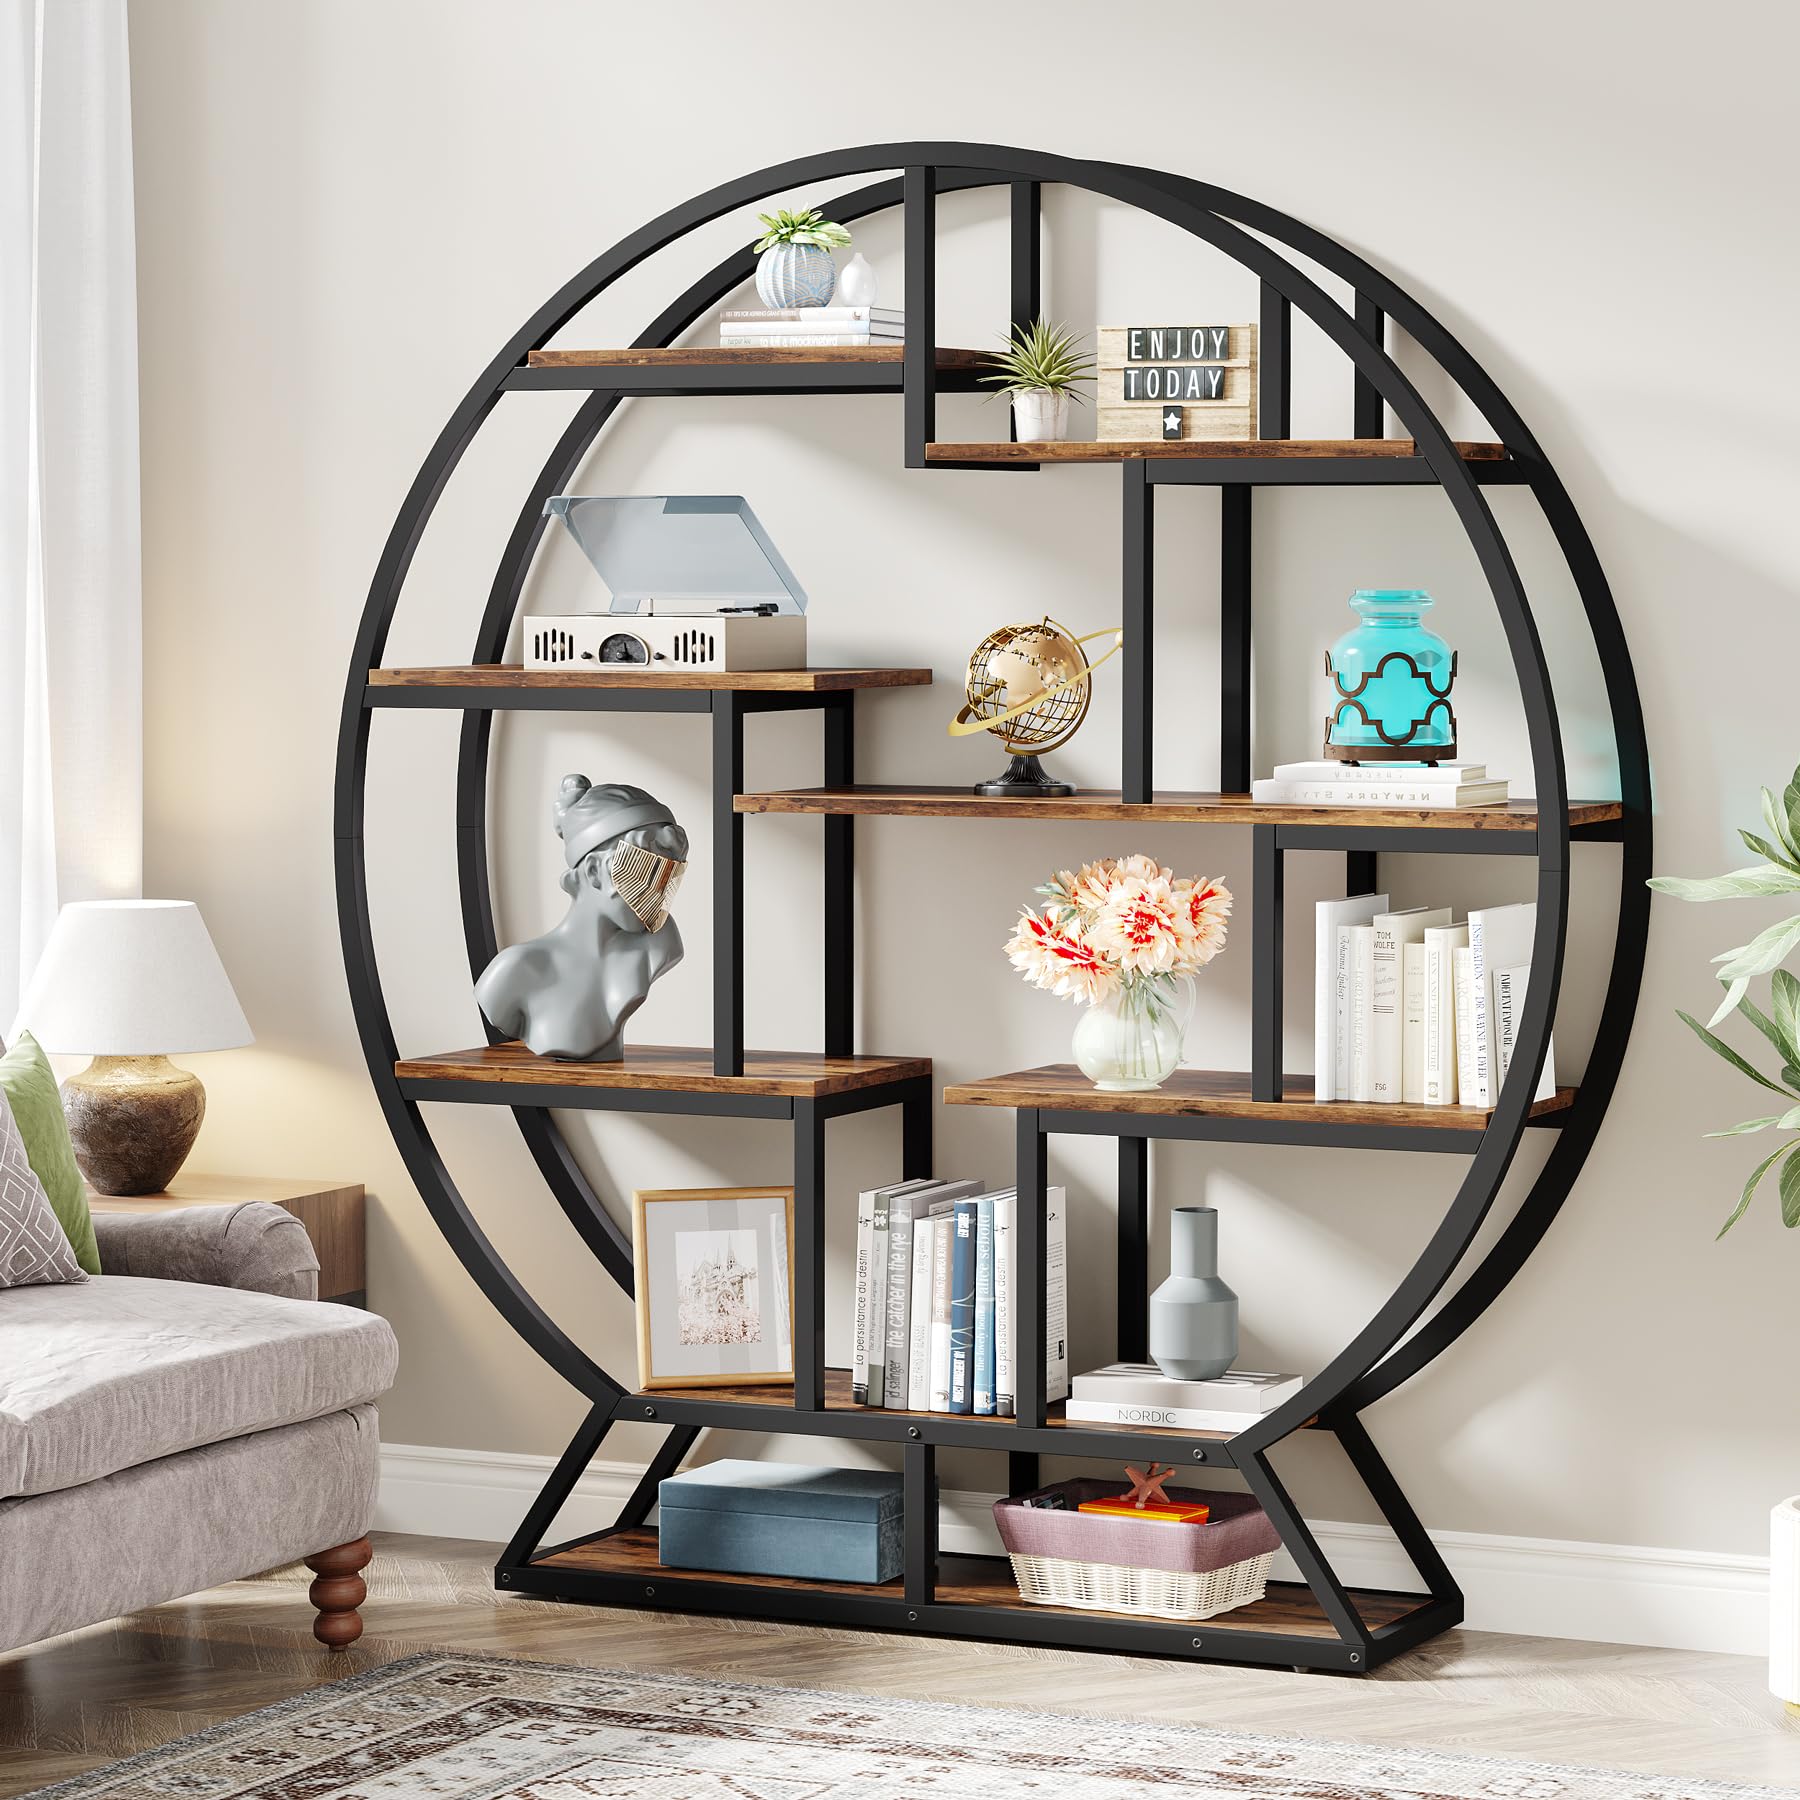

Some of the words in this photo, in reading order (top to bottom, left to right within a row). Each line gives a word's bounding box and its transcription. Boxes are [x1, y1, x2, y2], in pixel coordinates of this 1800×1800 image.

[1131, 329, 1225, 359] ENJOY
[1127, 369, 1221, 398] TODAY
[1373, 941, 1395, 950] WOLFE
[1376, 931, 1391, 939] TOM
[1339, 935, 1350, 970] Johanna
[1472, 923, 1483, 980] INSPIRATION
[1336, 971, 1348, 1000] Lindsey
[1430, 980, 1438, 1001] AND
[1457, 975, 1471, 1028] ARCTIC
[1430, 1005, 1438, 1025] THE
[1476, 1013, 1486, 1043] WAYNE
[1430, 1030, 1438, 1071] FUTURE
[1458, 1034, 1473, 1093] DREAMS
[1478, 1056, 1488, 1079] DYER
[1375, 1082, 1387, 1091] FSG
[891, 1232, 912, 1251] rye
[979, 1214, 991, 1259] sebold
[856, 1249, 868, 1278] destin
[888, 1251, 907, 1272] the
[997, 1257, 1009, 1286] destin
[856, 1281, 867, 1294] du
[888, 1272, 906, 1285] in
[978, 1260, 990, 1295] alice
[887, 1286, 906, 1327] catcher
[998, 1290, 1009, 1303] du
[856, 1297, 867, 1352] persistance
[999, 1307, 1011, 1361] persistance
[887, 1328, 905, 1348] the
[977, 1332, 988, 1356] lovely
[855, 1353, 864, 1366] La
[977, 1356, 985, 1371] the
[998, 1363, 1007, 1376] La
[886, 1360, 905, 1389] salinger
[1118, 1409, 1177, 1424] NORDIC
